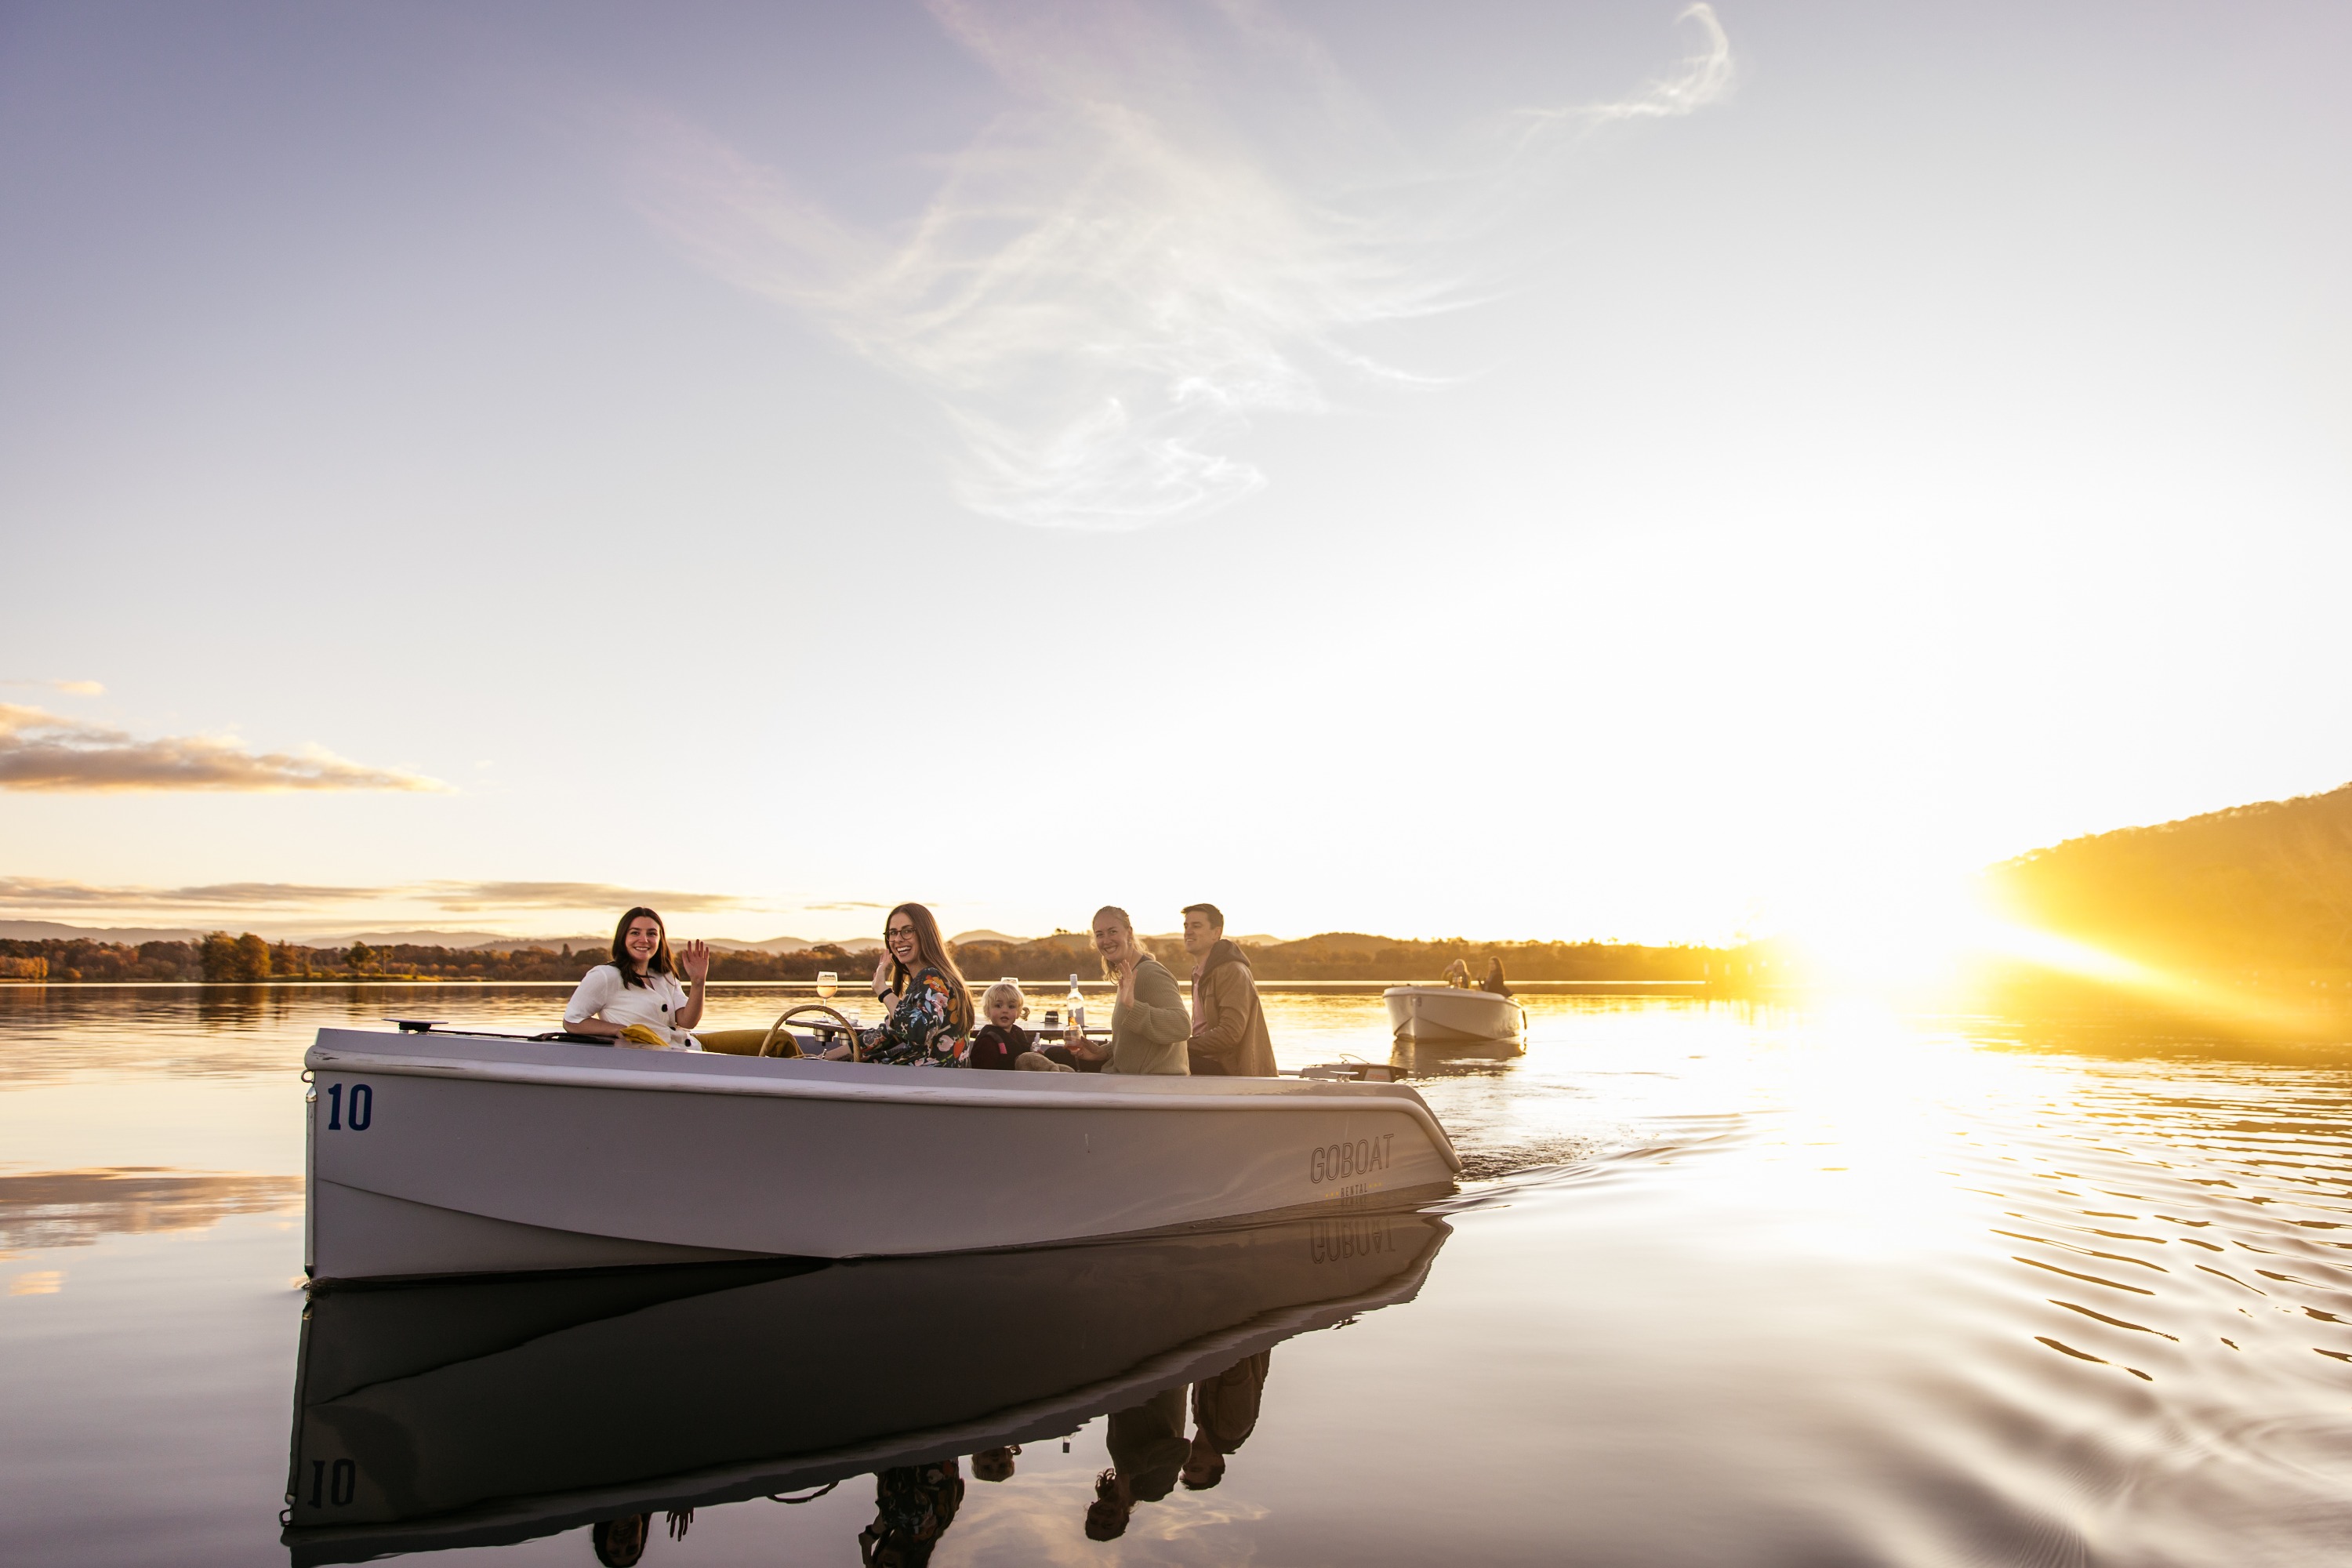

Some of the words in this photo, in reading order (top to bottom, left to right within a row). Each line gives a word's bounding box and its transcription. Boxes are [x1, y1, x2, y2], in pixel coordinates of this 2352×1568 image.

[328, 1083, 372, 1131] 10
[1310, 1134, 1394, 1183] GOBOAT
[1341, 1183, 1367, 1197] RENTAL
